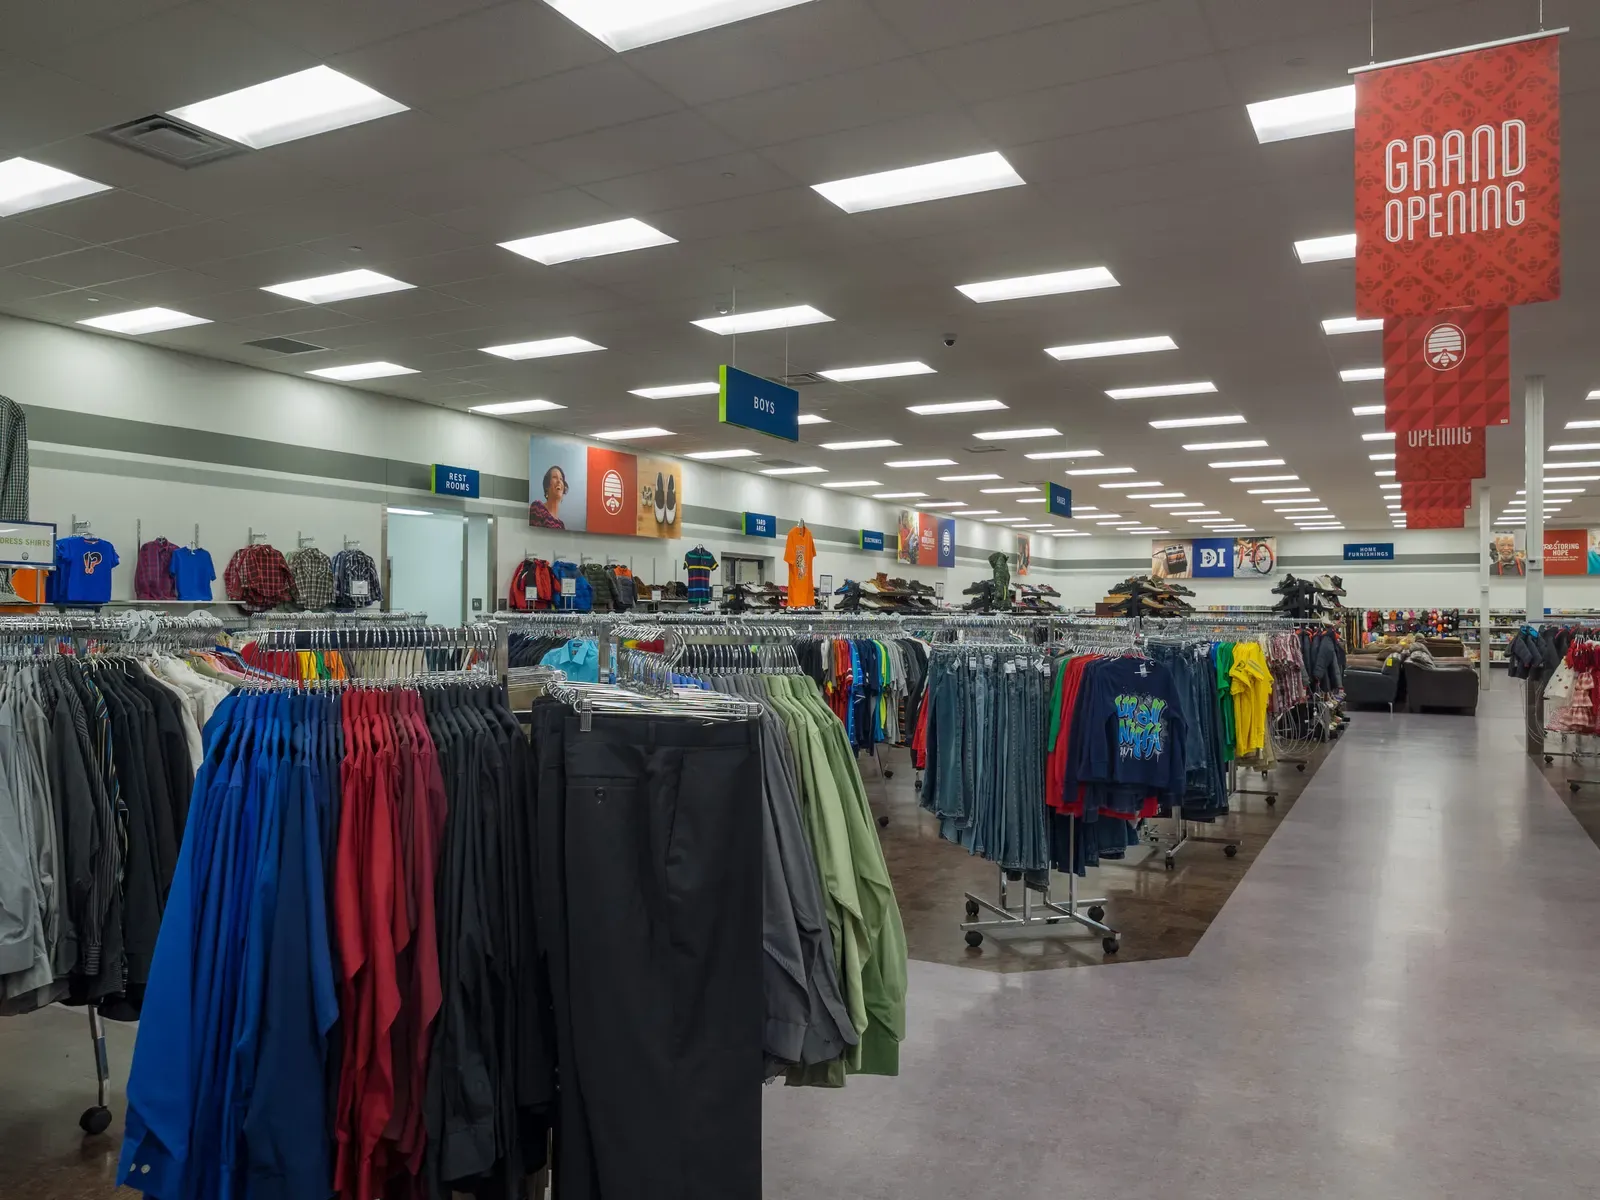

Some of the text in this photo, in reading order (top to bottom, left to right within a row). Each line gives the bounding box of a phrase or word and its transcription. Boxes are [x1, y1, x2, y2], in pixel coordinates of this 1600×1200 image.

[1385, 119, 1526, 194] GRAND
[1385, 181, 1526, 243] OPENING
[753, 396, 775, 414] BOYS
[1408, 426, 1472, 447] OPENING
[445, 480, 470, 491] ROOMS
[449, 472, 467, 482] REST
[25, 539, 51, 547] SHIRTS
[1200, 548, 1226, 567] DI
